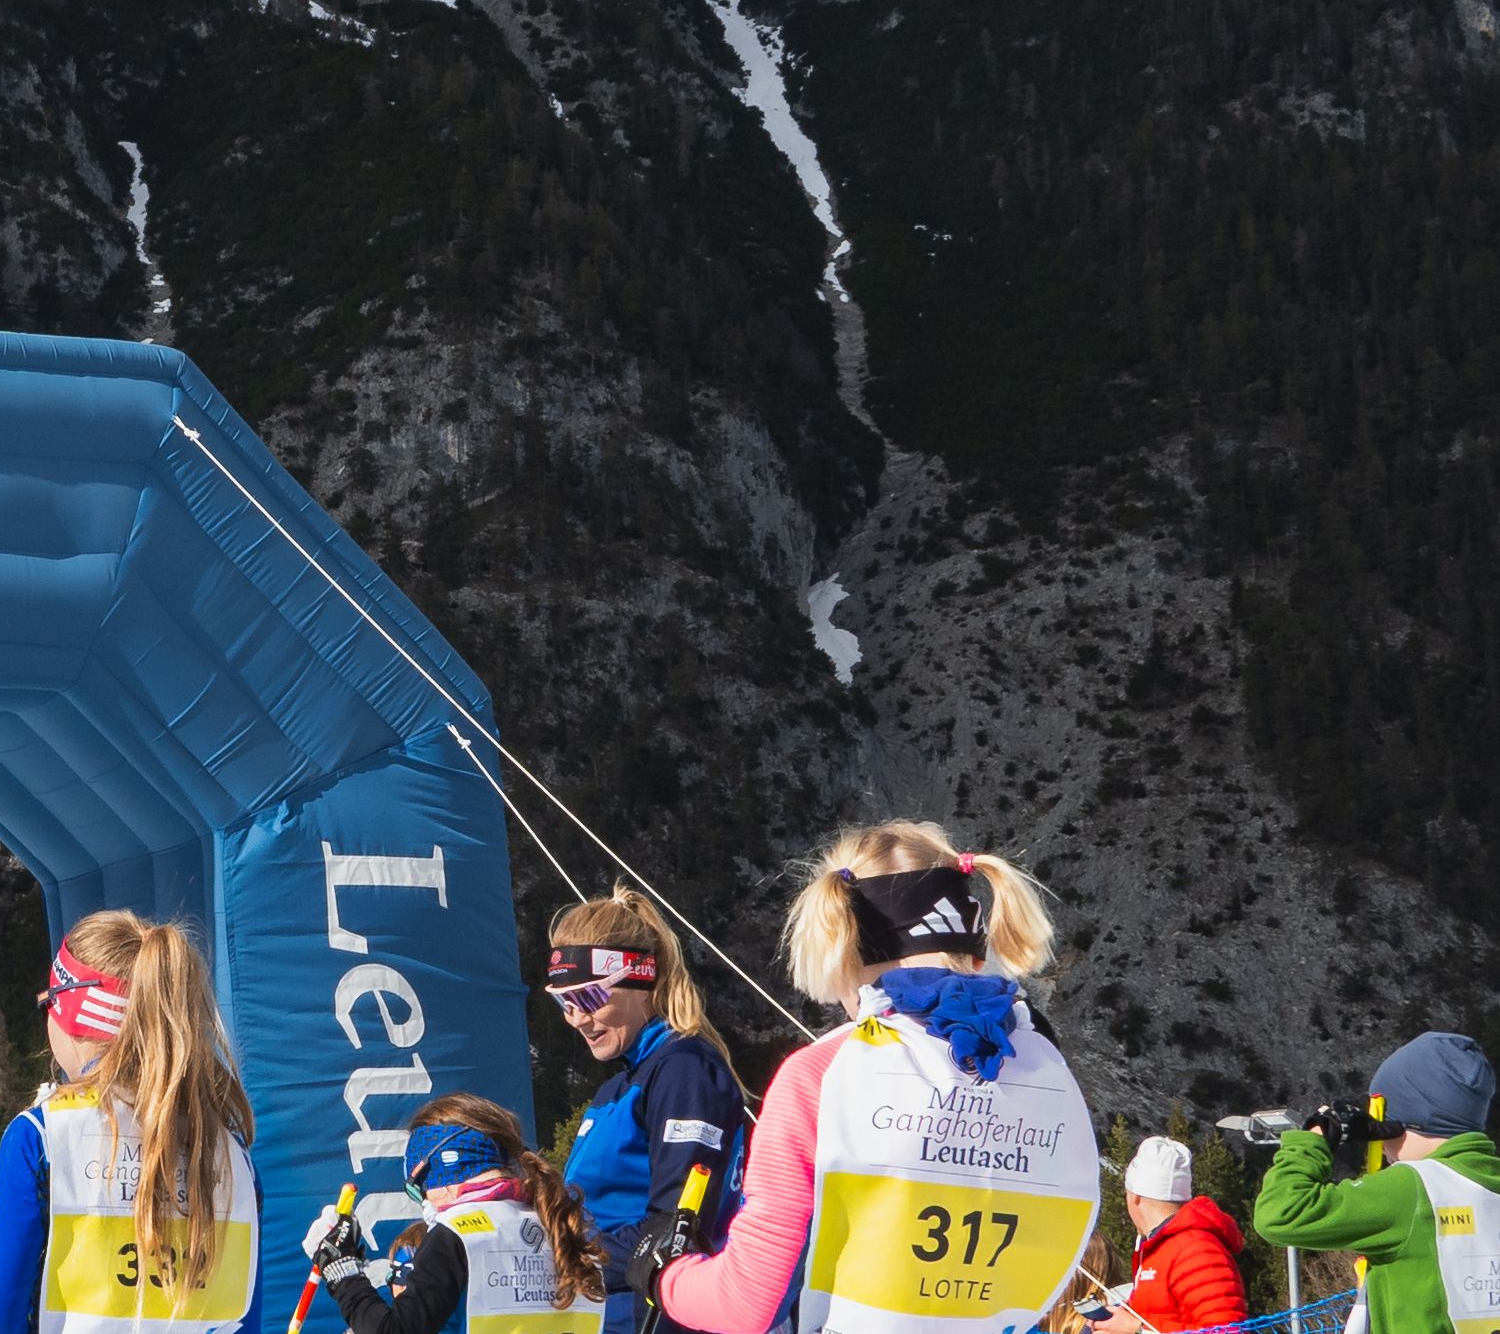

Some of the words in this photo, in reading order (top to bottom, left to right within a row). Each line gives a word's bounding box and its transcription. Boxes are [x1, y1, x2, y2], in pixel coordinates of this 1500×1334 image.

[928, 1086, 993, 1115] Mini
[871, 1105, 1065, 1157] Ganghoferlauf
[920, 1136, 1030, 1173] Leutasch
[456, 1215, 488, 1229] MINI
[1440, 1214, 1471, 1226] MINI
[670, 1220, 690, 1258] LEKI
[911, 1204, 1020, 1268] 317
[513, 1255, 545, 1273] Mini
[919, 1275, 993, 1301] LOTTE
